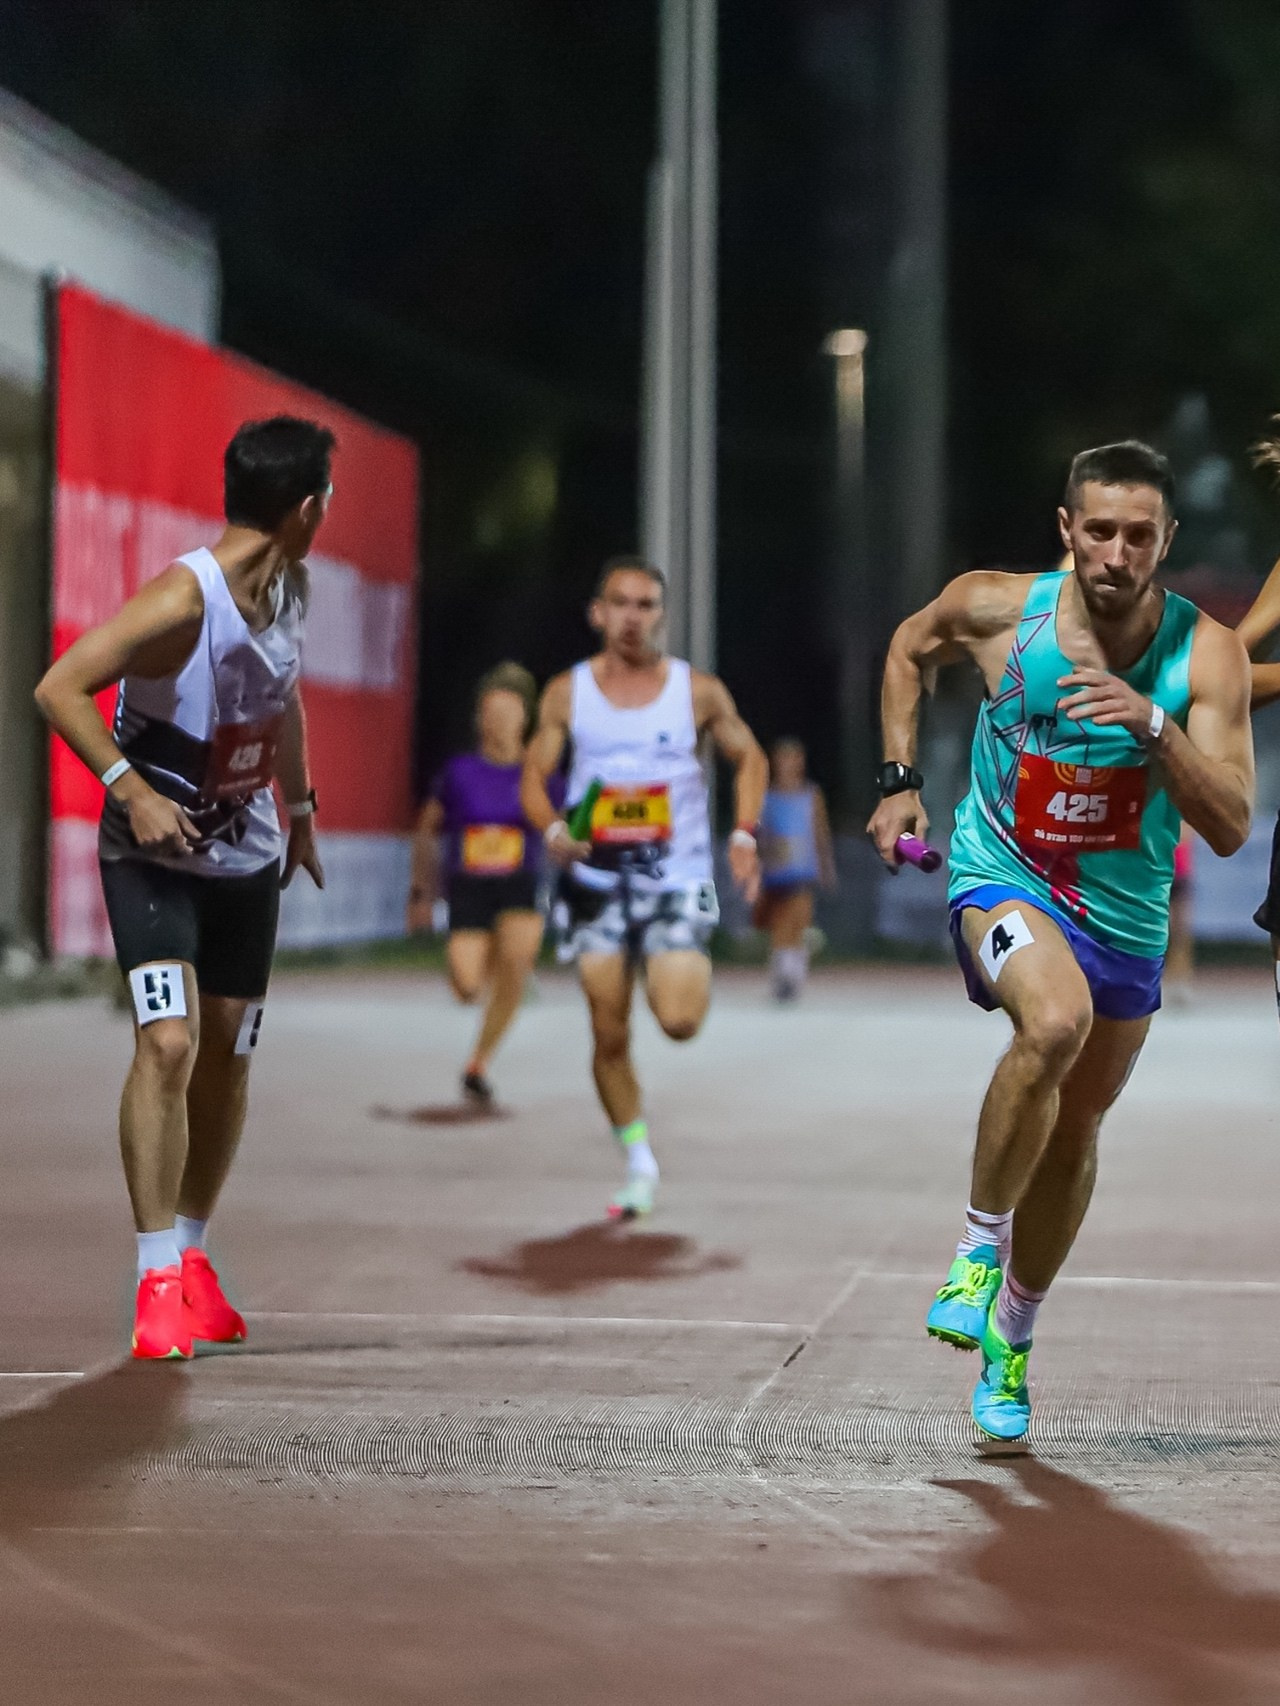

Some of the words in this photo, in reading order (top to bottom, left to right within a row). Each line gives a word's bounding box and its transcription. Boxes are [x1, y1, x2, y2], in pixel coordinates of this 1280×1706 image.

[1046, 791, 1108, 823] 425
[992, 923, 1015, 961] 4
[143, 970, 171, 1011] 5
